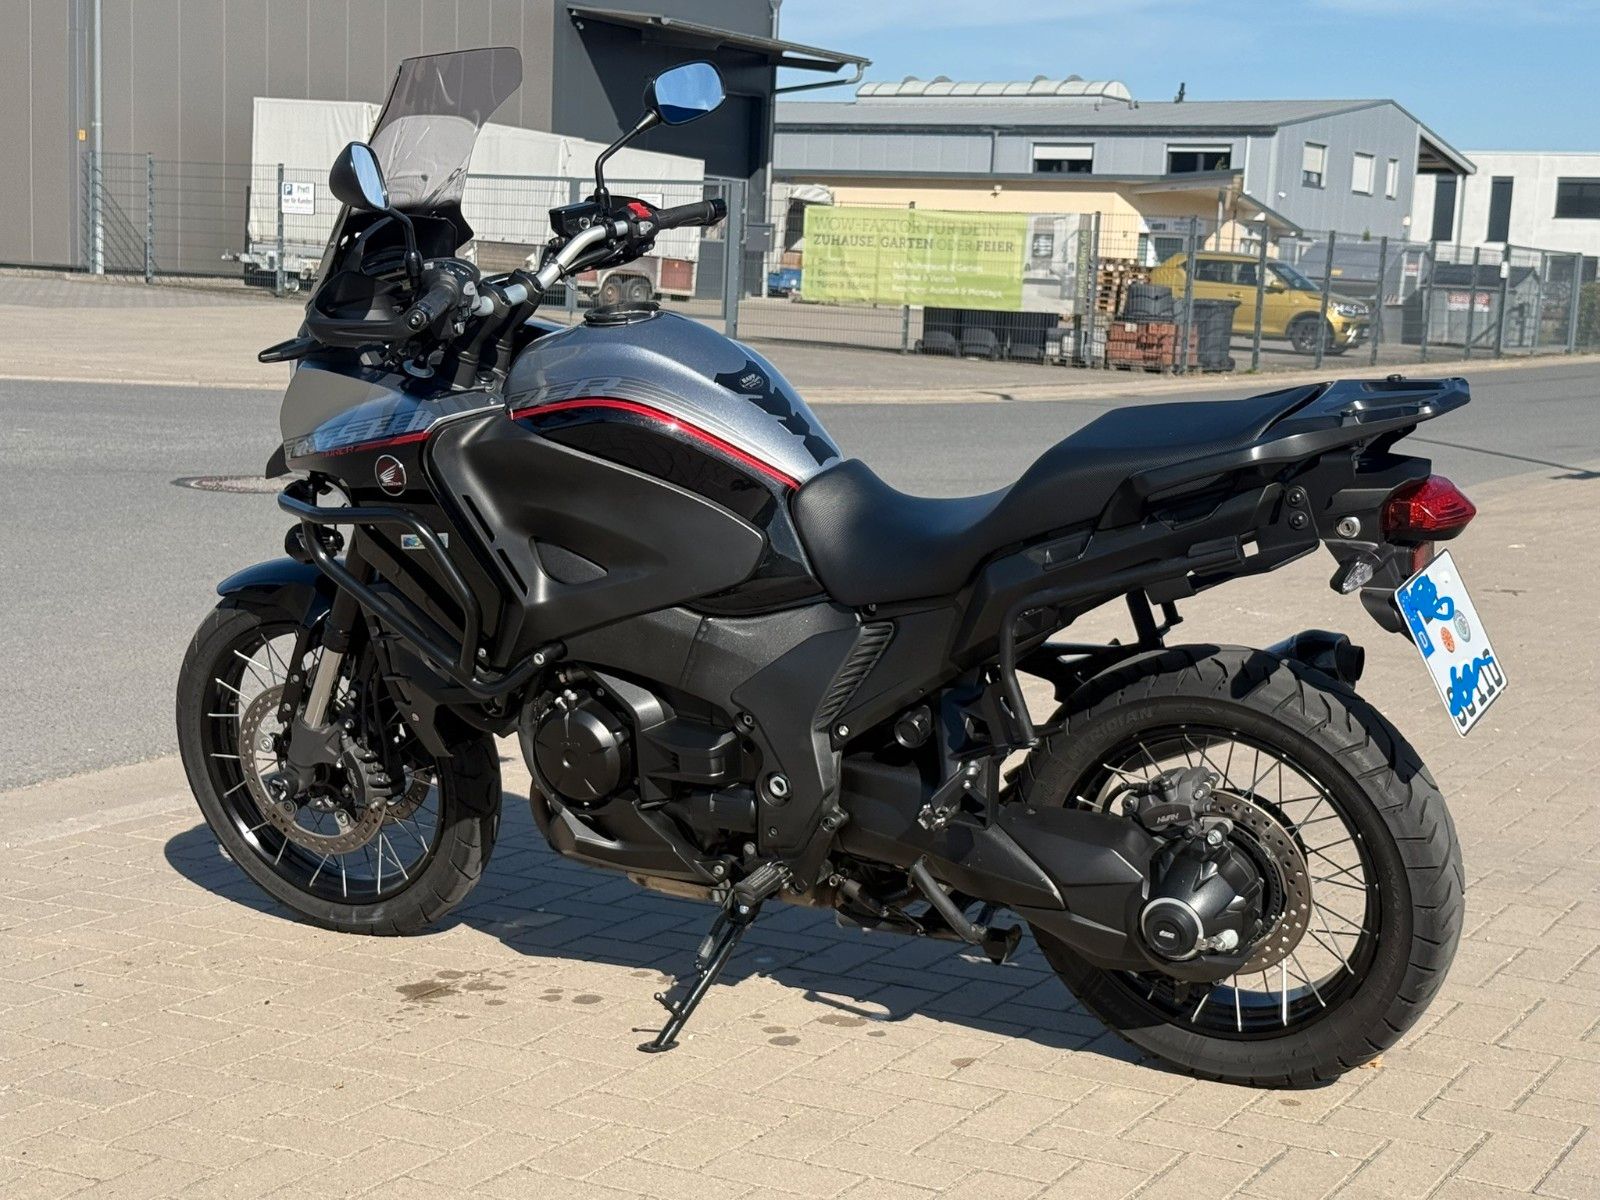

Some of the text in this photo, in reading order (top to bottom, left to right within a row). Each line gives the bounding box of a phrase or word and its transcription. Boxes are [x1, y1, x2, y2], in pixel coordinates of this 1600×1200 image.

[880, 236, 933, 249] GARTEN
[936, 239, 972, 251] ODER
[975, 240, 1013, 252] FEIER
